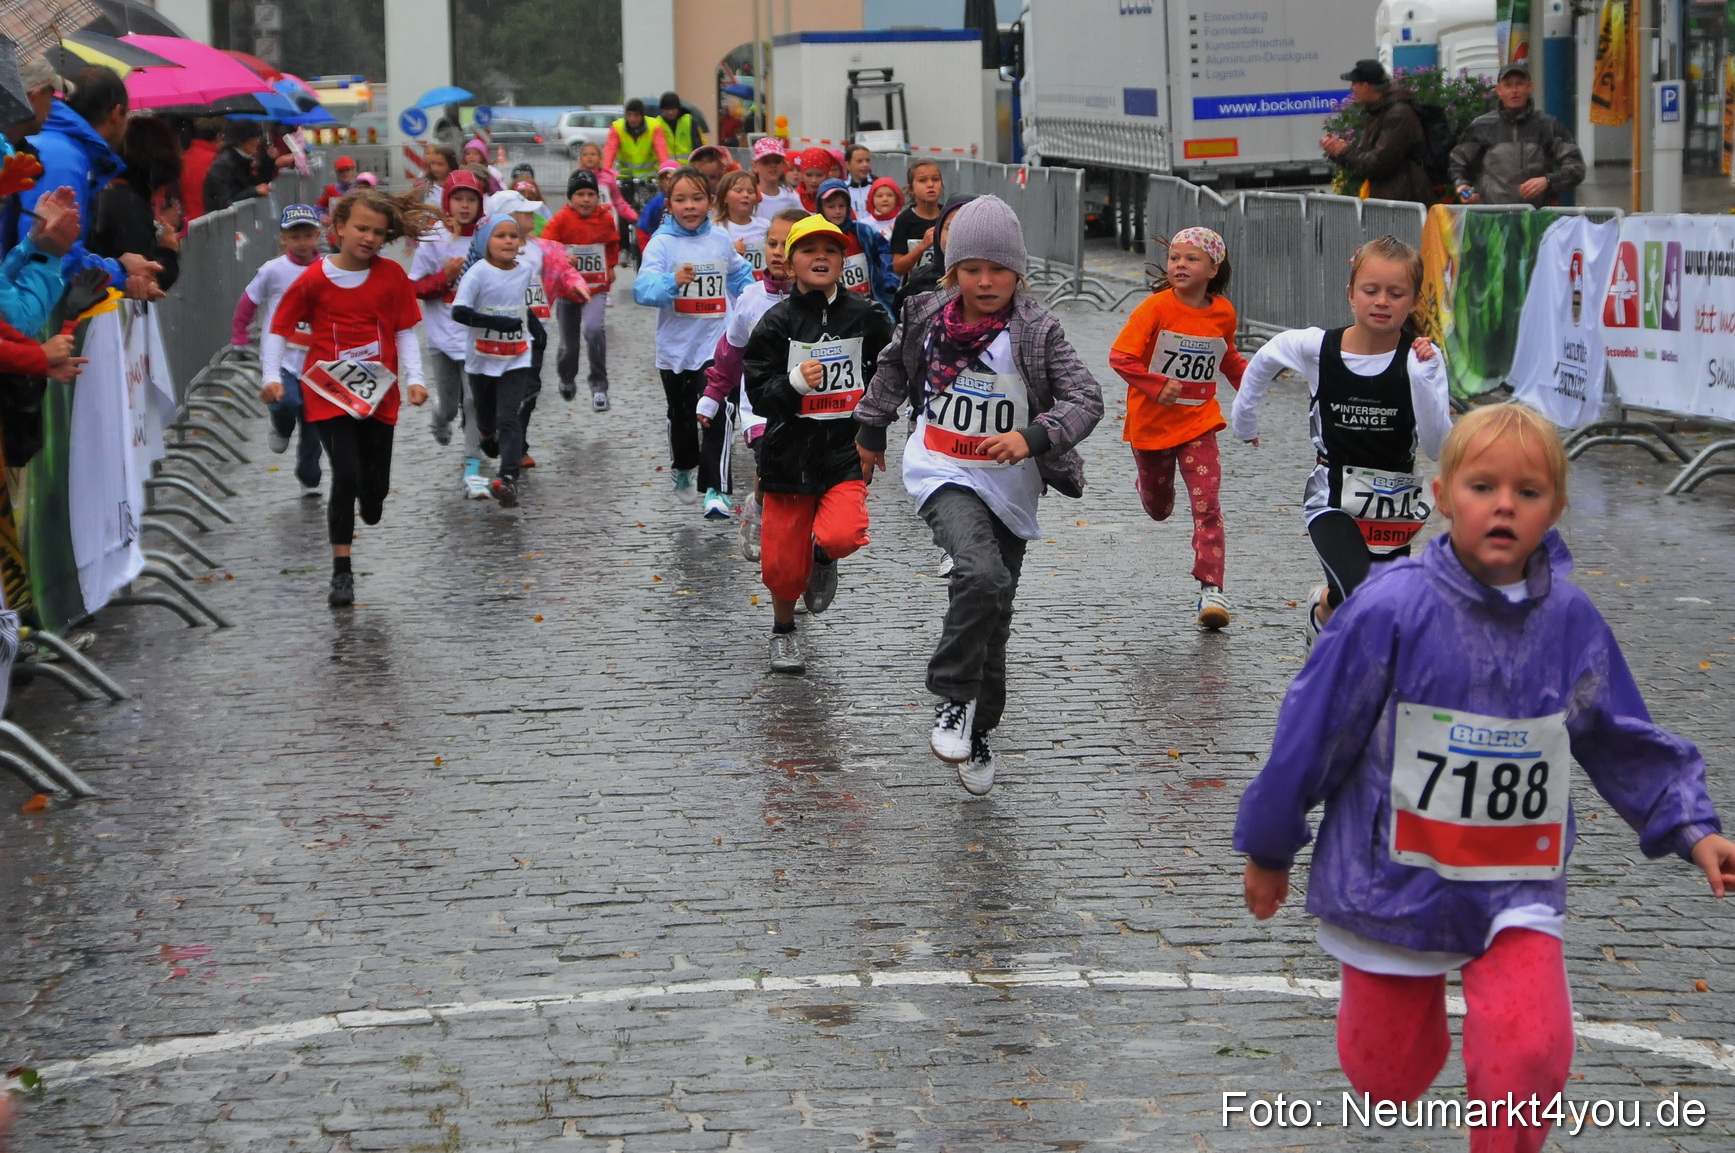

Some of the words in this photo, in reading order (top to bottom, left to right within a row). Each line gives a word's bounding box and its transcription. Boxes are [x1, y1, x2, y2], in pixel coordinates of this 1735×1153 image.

[1203, 11, 1268, 22] Entwicklung
[1204, 25, 1264, 36] Formenbau
[1205, 38, 1296, 50] Kunststofftechnik
[1205, 51, 1320, 65] Aluminium-Druckguss
[1206, 69, 1247, 81] Logistik
[1665, 89, 1677, 107] P
[574, 255, 602, 271] 066
[525, 288, 545, 306] 042
[811, 345, 842, 358] BOCK
[1180, 339, 1211, 350] BOCK
[1161, 349, 1216, 381] 7368
[814, 360, 855, 393] 023
[953, 375, 995, 393] BOCK
[809, 397, 847, 412] Lillian
[1340, 403, 1399, 416] INTERSPORT
[935, 391, 1015, 434] 7010
[1342, 414, 1388, 426] LANGE
[1450, 724, 1529, 748] BOCK
[1416, 751, 1550, 821] 7188
